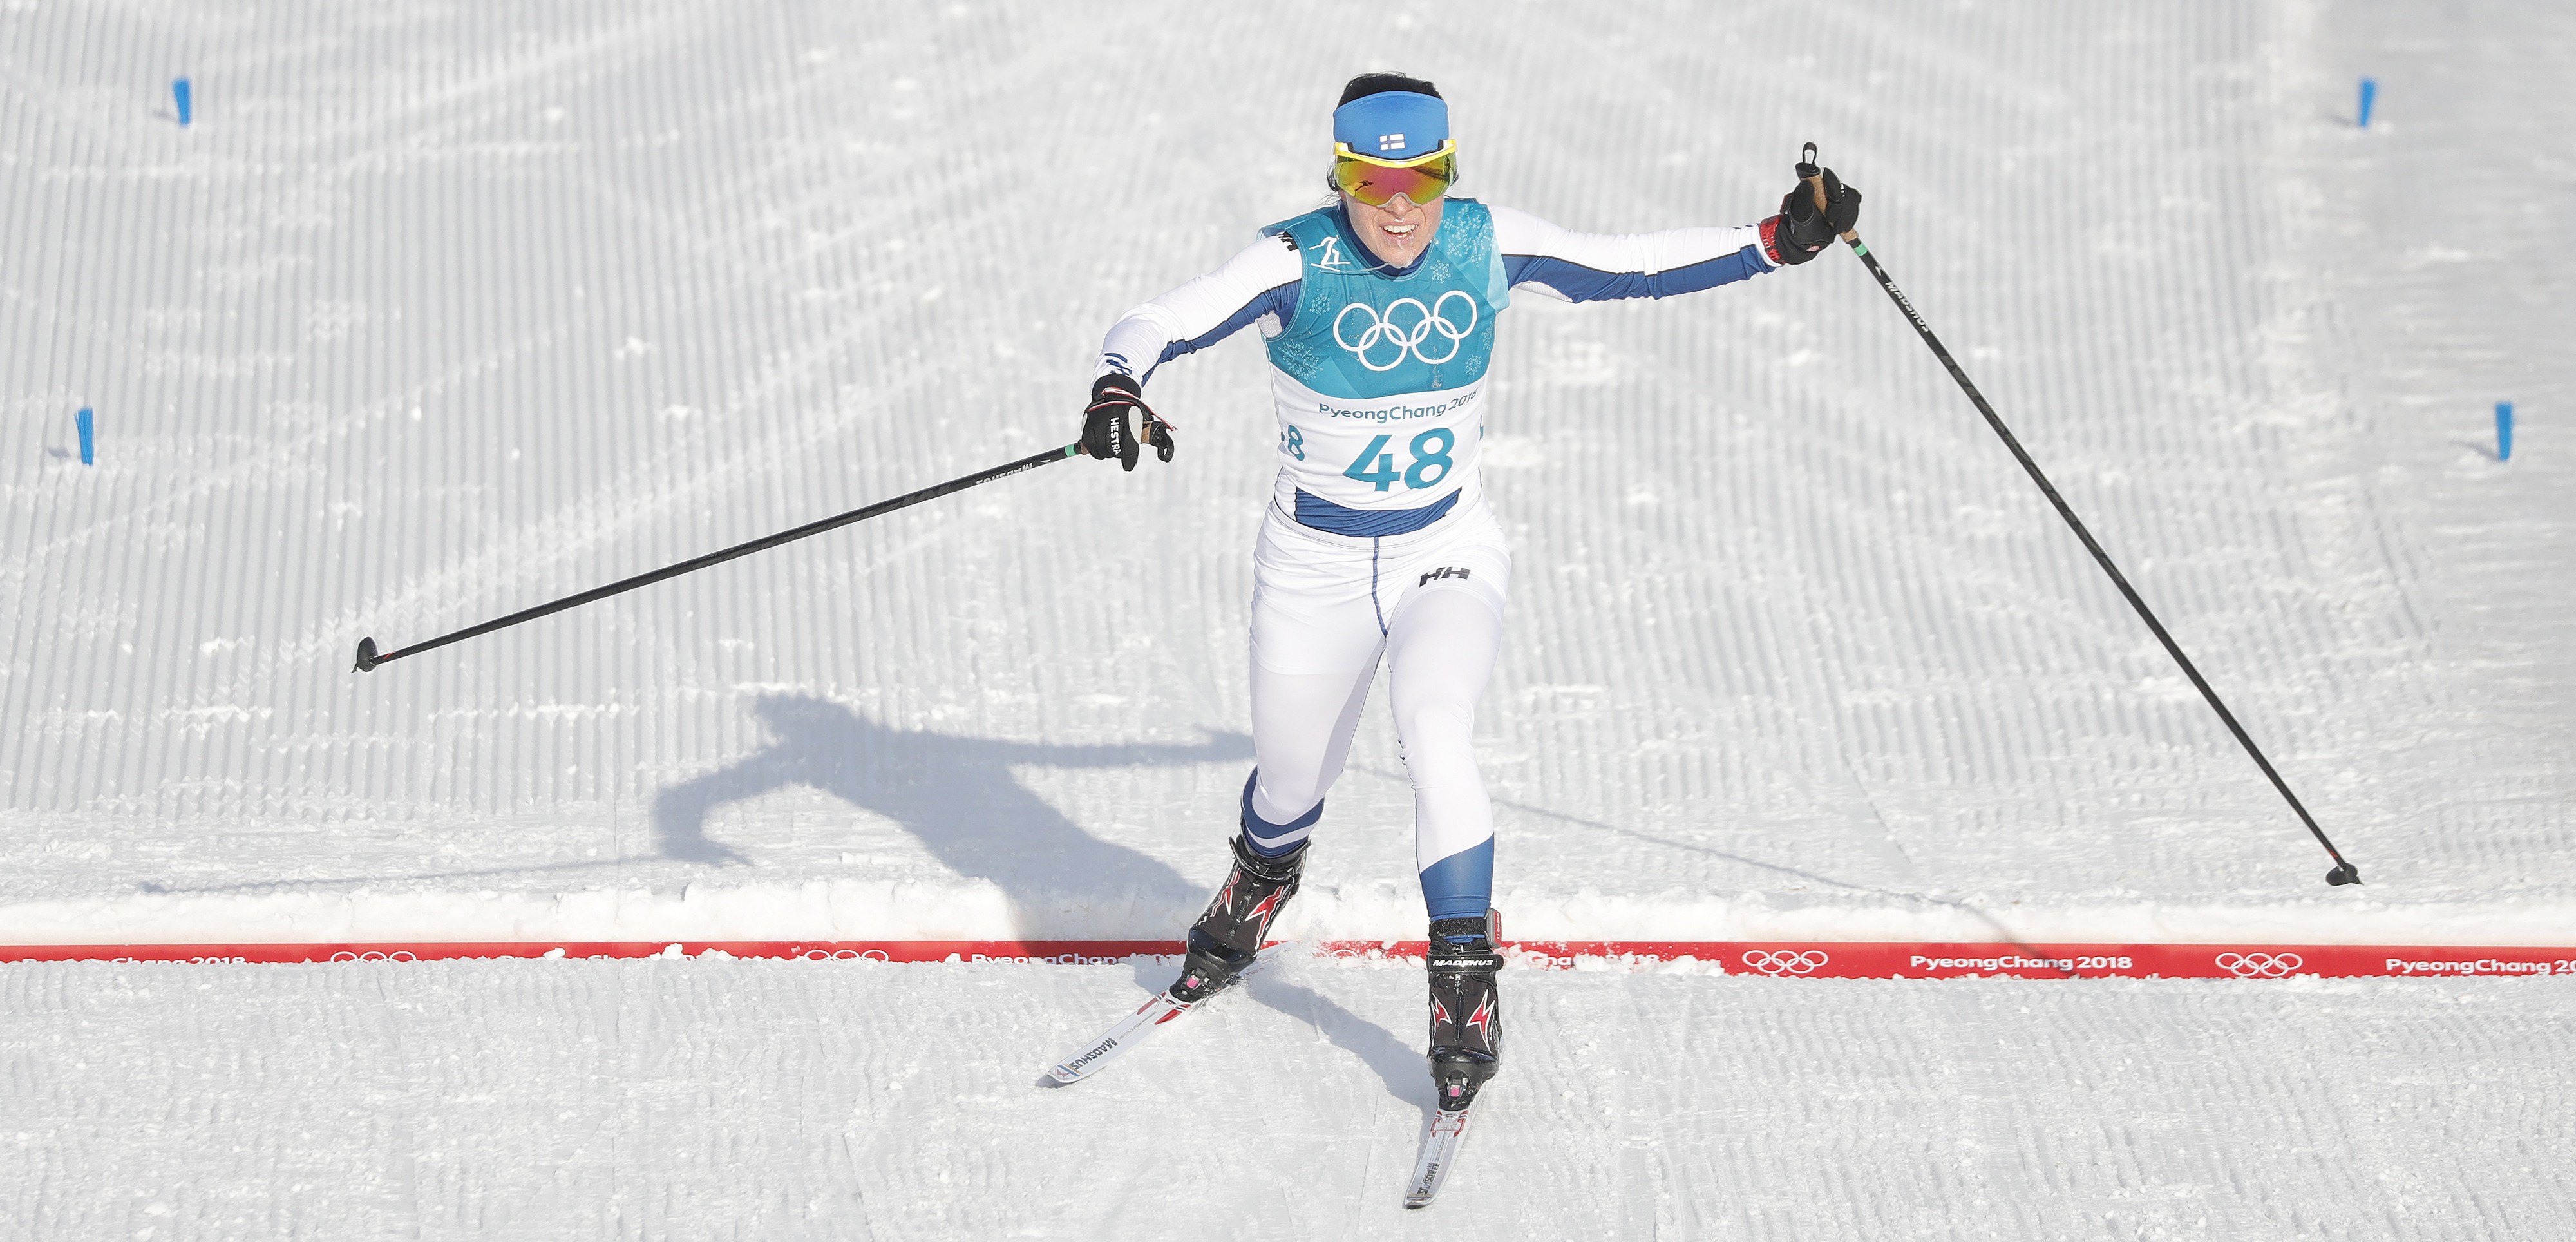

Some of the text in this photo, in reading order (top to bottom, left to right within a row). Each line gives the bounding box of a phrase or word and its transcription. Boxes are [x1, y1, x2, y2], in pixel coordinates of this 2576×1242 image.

[1319, 403, 1447, 423] PyeongChang
[1110, 417, 1122, 455] HESTRA
[1280, 424, 1305, 462] 8
[1342, 427, 1455, 492] 48
[1419, 566, 1471, 588] HH
[1909, 955, 2133, 971] PyeongChang 2018
[2385, 958, 2552, 975] PyeongChang
[1068, 1037, 1118, 1071] MADSHUS
